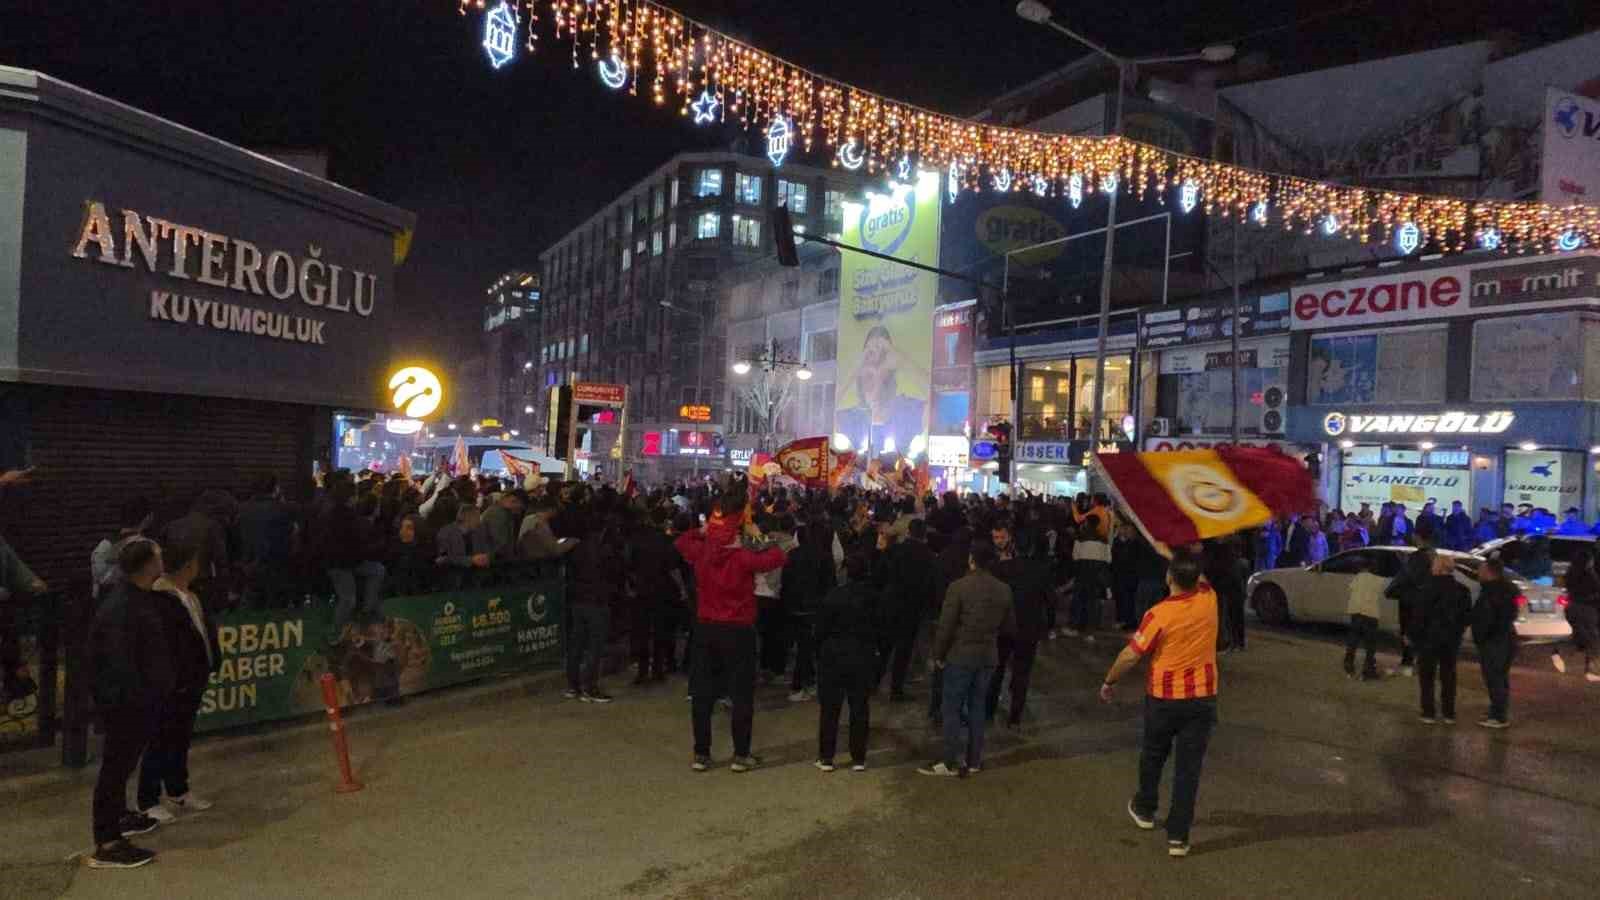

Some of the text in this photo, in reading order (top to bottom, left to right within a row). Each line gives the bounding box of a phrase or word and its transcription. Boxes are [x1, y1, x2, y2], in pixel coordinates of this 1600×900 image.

[868, 205, 905, 236] gratis
[73, 200, 377, 316] ANTEROĞLU
[1294, 274, 1461, 320] eczane
[151, 291, 325, 344] KUYUMCULUK
[1351, 411, 1516, 434] VANGÖLÜ
[218, 619, 304, 654] RBAN
[209, 653, 285, 684] ABER
[197, 684, 257, 715] SUN
